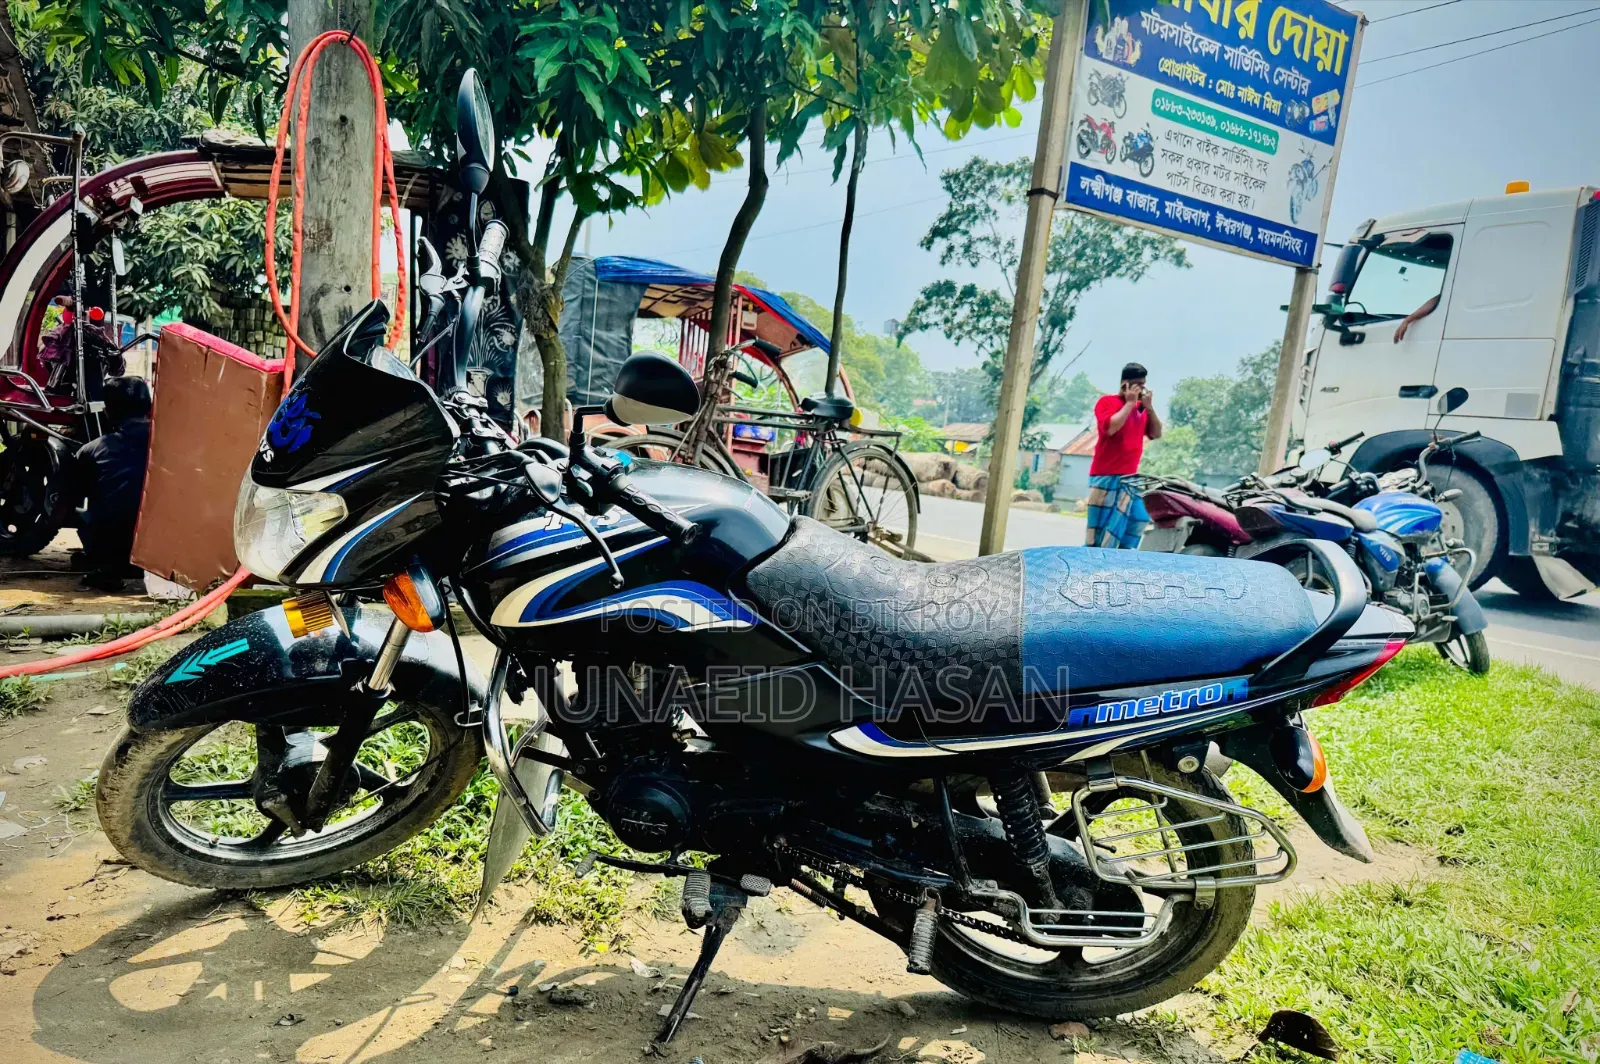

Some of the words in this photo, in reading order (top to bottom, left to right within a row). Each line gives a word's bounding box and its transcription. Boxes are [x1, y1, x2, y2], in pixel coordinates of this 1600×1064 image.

[1140, 7, 1221, 63] মটরসাইকেল
[1223, 44, 1270, 84] সার্ভিসিং
[1273, 66, 1312, 98] সেন্টার
[1267, 6, 1349, 76] দোয়া
[1215, 79, 1235, 99] মোঃ
[1262, 91, 1283, 117] মিয়া
[1160, 148, 1184, 167] সকল
[1186, 156, 1211, 176] প্রকার
[1213, 163, 1231, 182] মটর
[1234, 171, 1267, 193] সাইকেল
[1164, 129, 1193, 148] এখানে
[1196, 136, 1219, 157] বাইক
[1221, 145, 1254, 171] সার্ভিসিং
[1256, 159, 1269, 175] সহ
[1192, 175, 1218, 199] বিক্রয়
[1219, 188, 1236, 206] করা
[1095, 682, 1223, 723] metro
